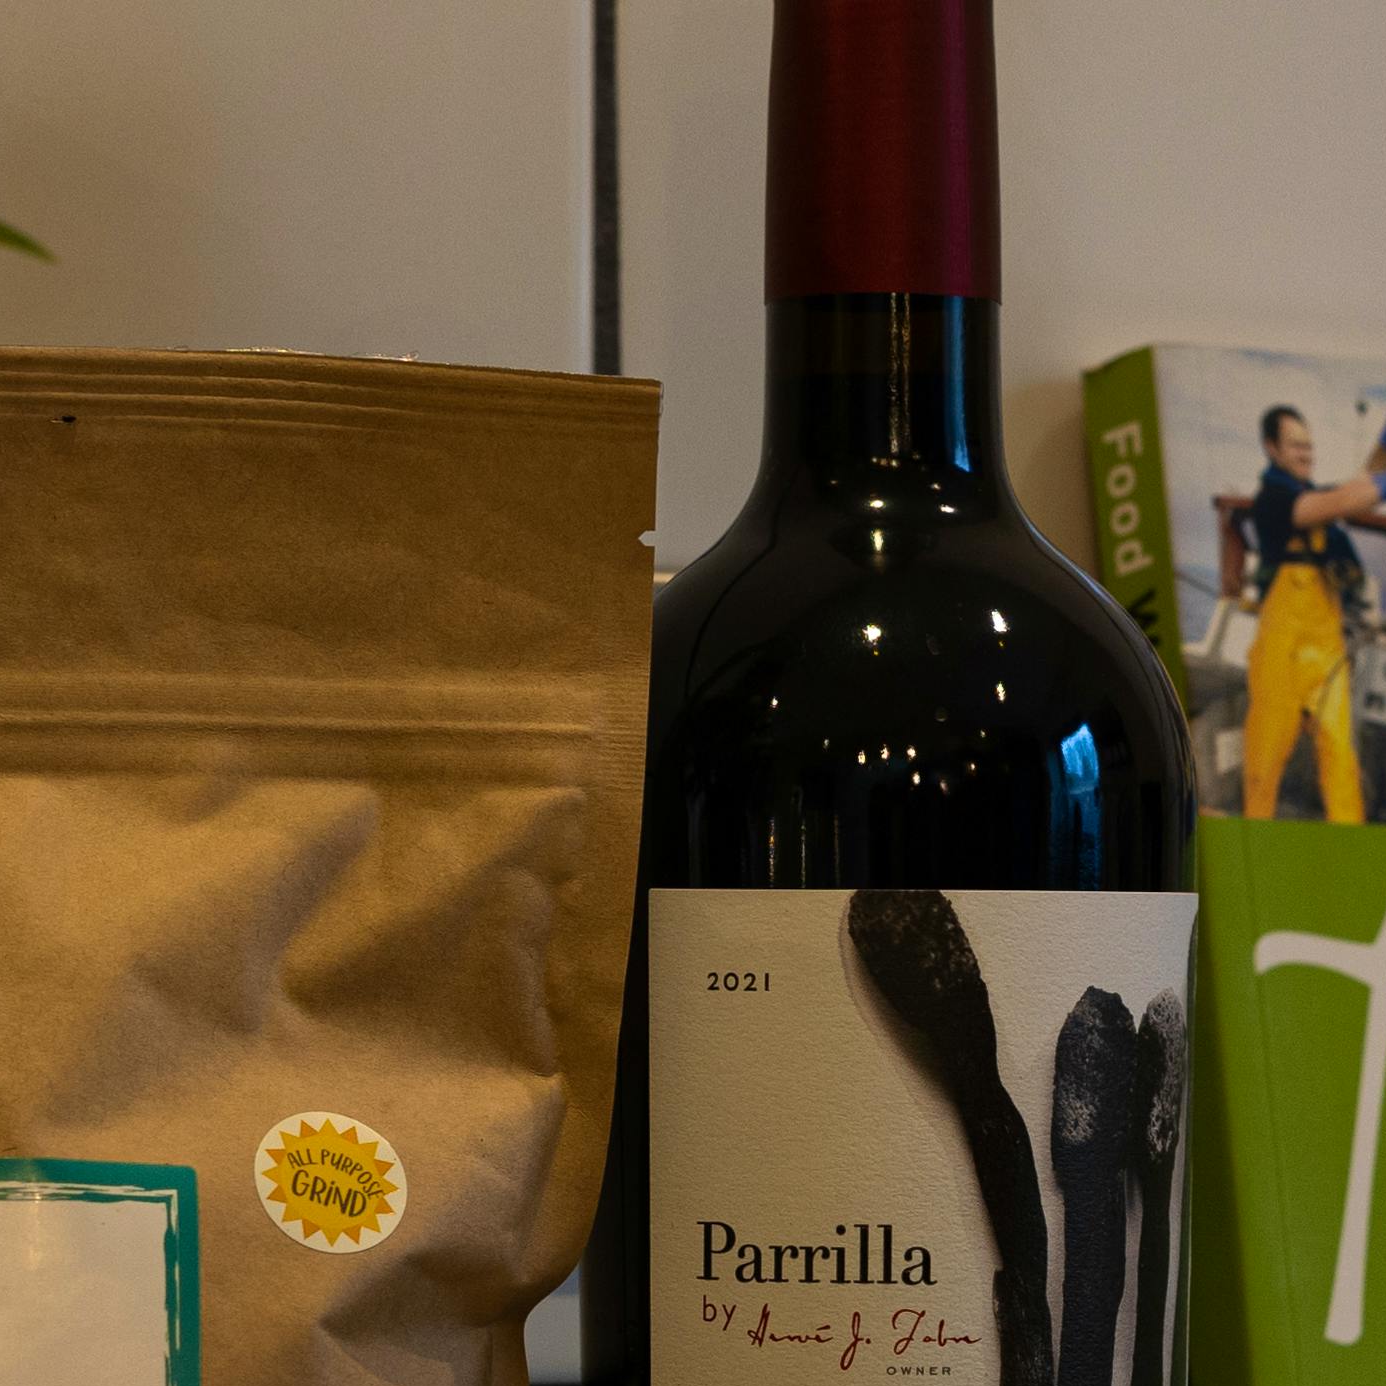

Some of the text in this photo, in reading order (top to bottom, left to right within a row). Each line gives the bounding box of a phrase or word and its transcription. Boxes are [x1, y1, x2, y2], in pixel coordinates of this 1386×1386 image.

[1102, 422, 1154, 576] Food
[707, 972, 770, 991] 2021
[287, 1148, 386, 1200] ALL PURPOSE
[696, 1221, 938, 1286] Parrilla
[702, 1294, 736, 1331] by
[886, 1366, 952, 1377] OWNER
